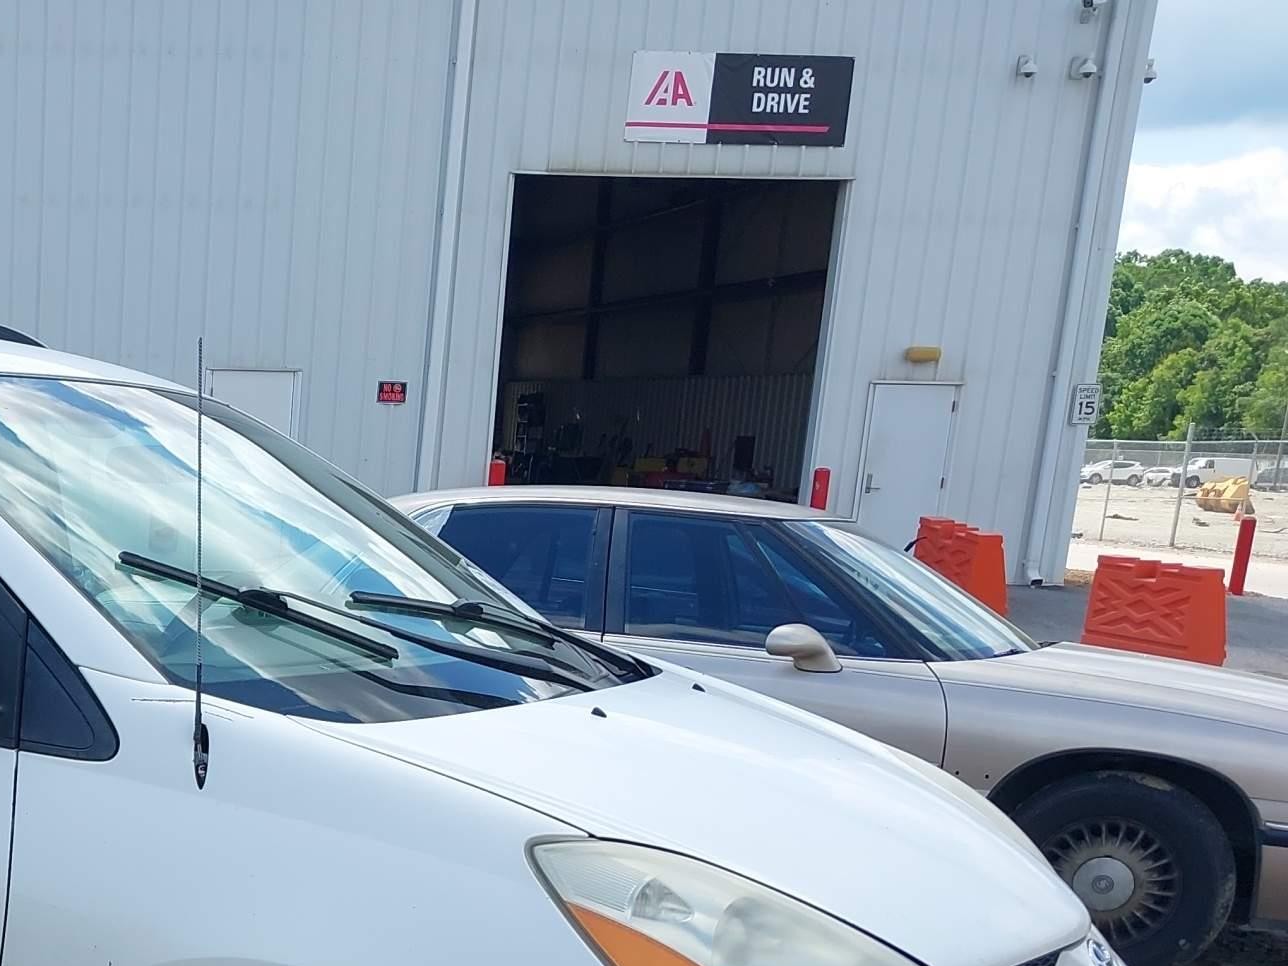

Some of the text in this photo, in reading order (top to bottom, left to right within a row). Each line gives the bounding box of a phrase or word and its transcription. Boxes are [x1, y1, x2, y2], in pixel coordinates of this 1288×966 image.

[752, 66, 815, 89] RUN &
[751, 92, 811, 114] DRIVE
[383, 383, 392, 392] NO
[379, 392, 404, 401] SMOKING
[1078, 401, 1096, 415] 15
